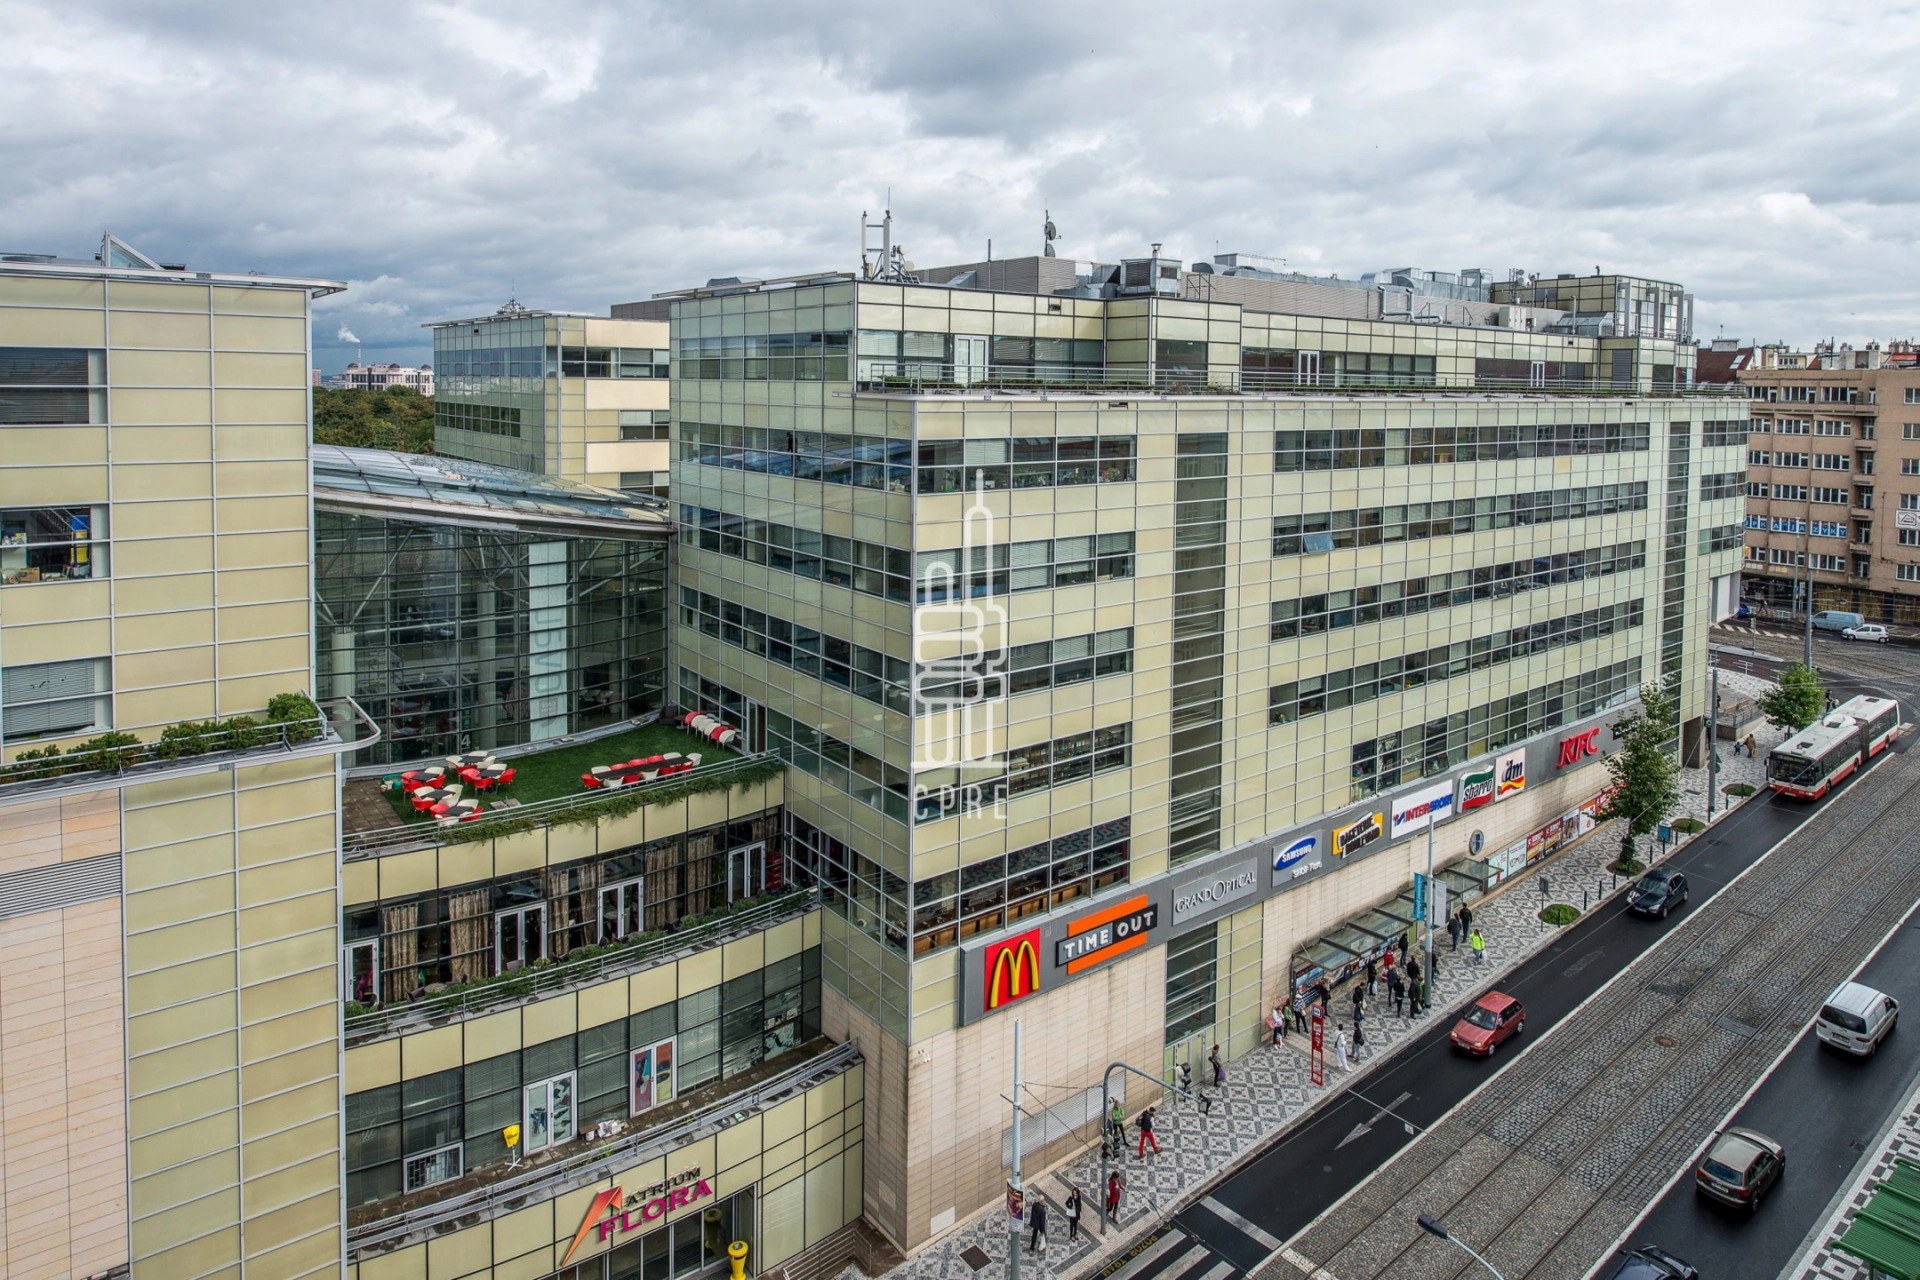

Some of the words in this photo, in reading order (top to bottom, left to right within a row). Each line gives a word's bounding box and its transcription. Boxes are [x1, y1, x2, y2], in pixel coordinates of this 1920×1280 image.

[1557, 727, 1601, 769] KFC
[1504, 759, 1523, 782] dm
[1464, 779, 1493, 802] sbarro
[1405, 793, 1454, 823] INTERSPORT
[1282, 844, 1312, 863] SAMSUNG
[1292, 866, 1309, 879] SHOP
[1064, 929, 1110, 959] TIME
[1117, 911, 1154, 938] OUT
[626, 1166, 701, 1207] ATRIUM
[600, 1178, 713, 1242] FLORA
[1129, 1234, 1158, 1257] POZOR
